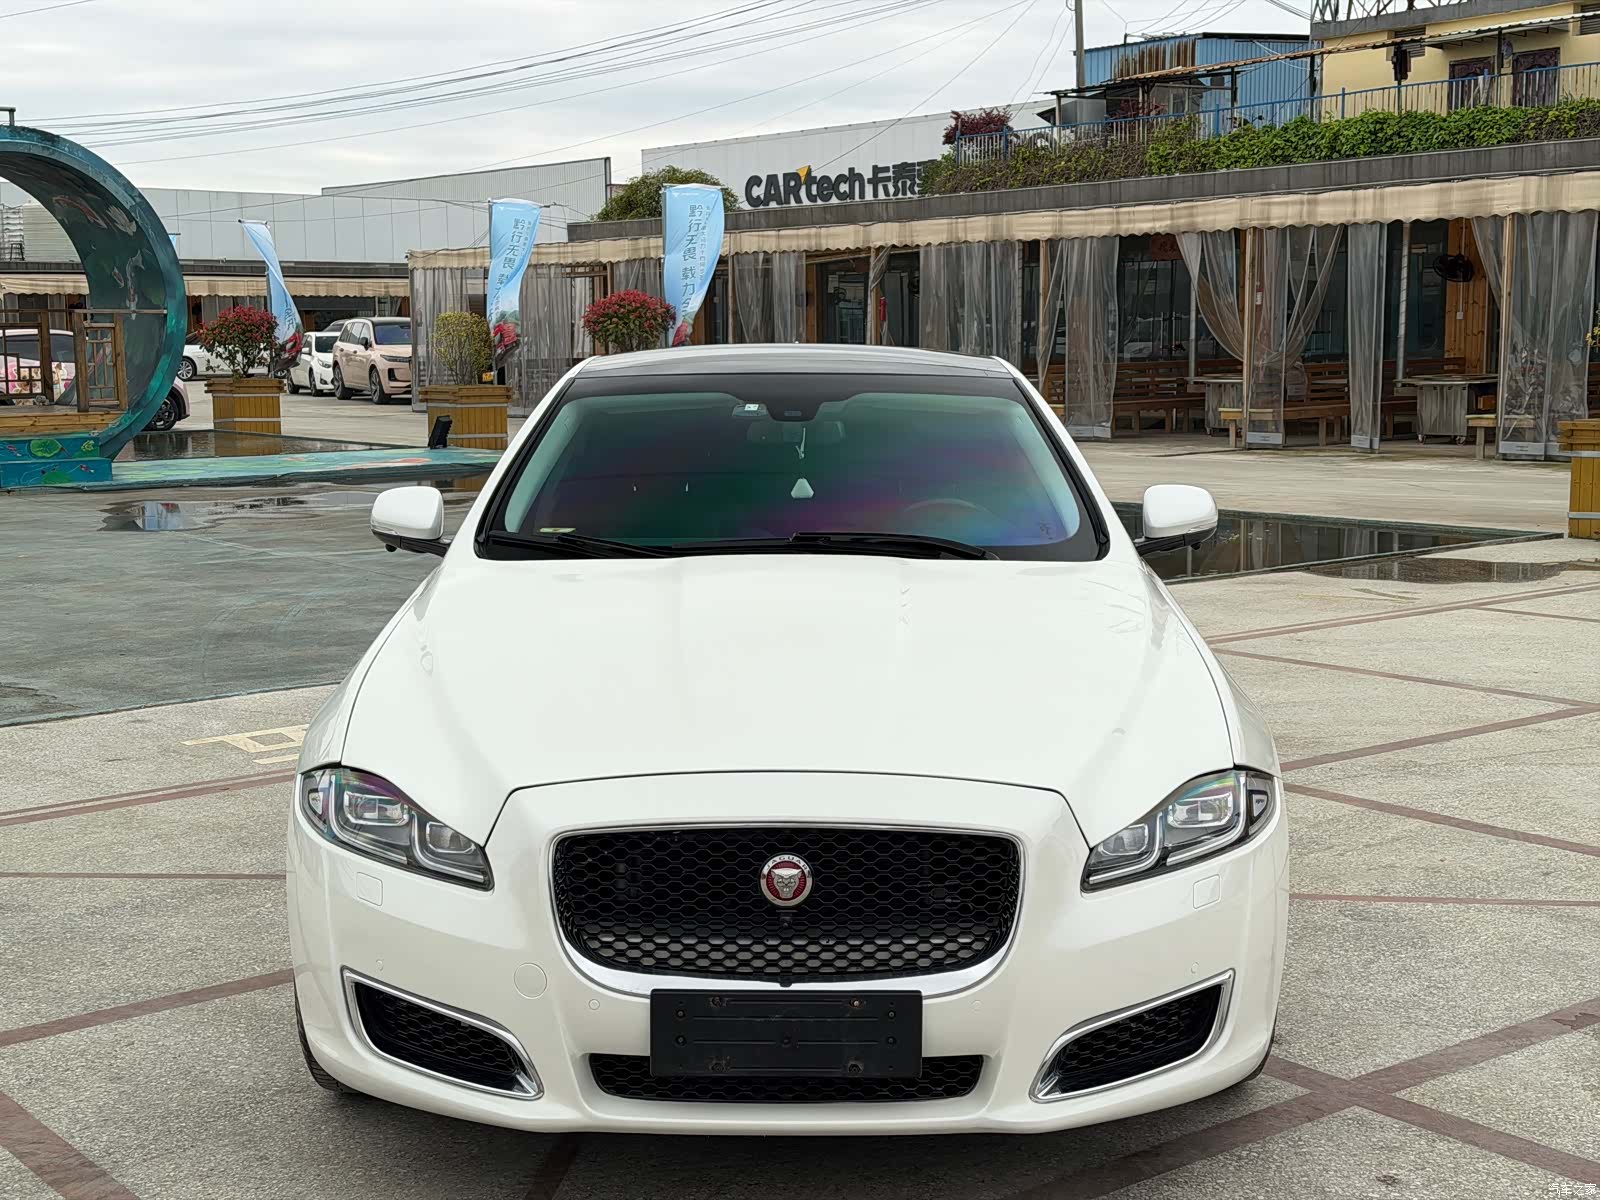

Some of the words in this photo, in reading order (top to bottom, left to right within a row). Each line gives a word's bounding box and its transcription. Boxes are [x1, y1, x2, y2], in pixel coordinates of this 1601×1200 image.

[745, 165, 866, 208] CARtech
[682, 204, 704, 262] 黔行无畏
[766, 855, 808, 871] JAGUAR
